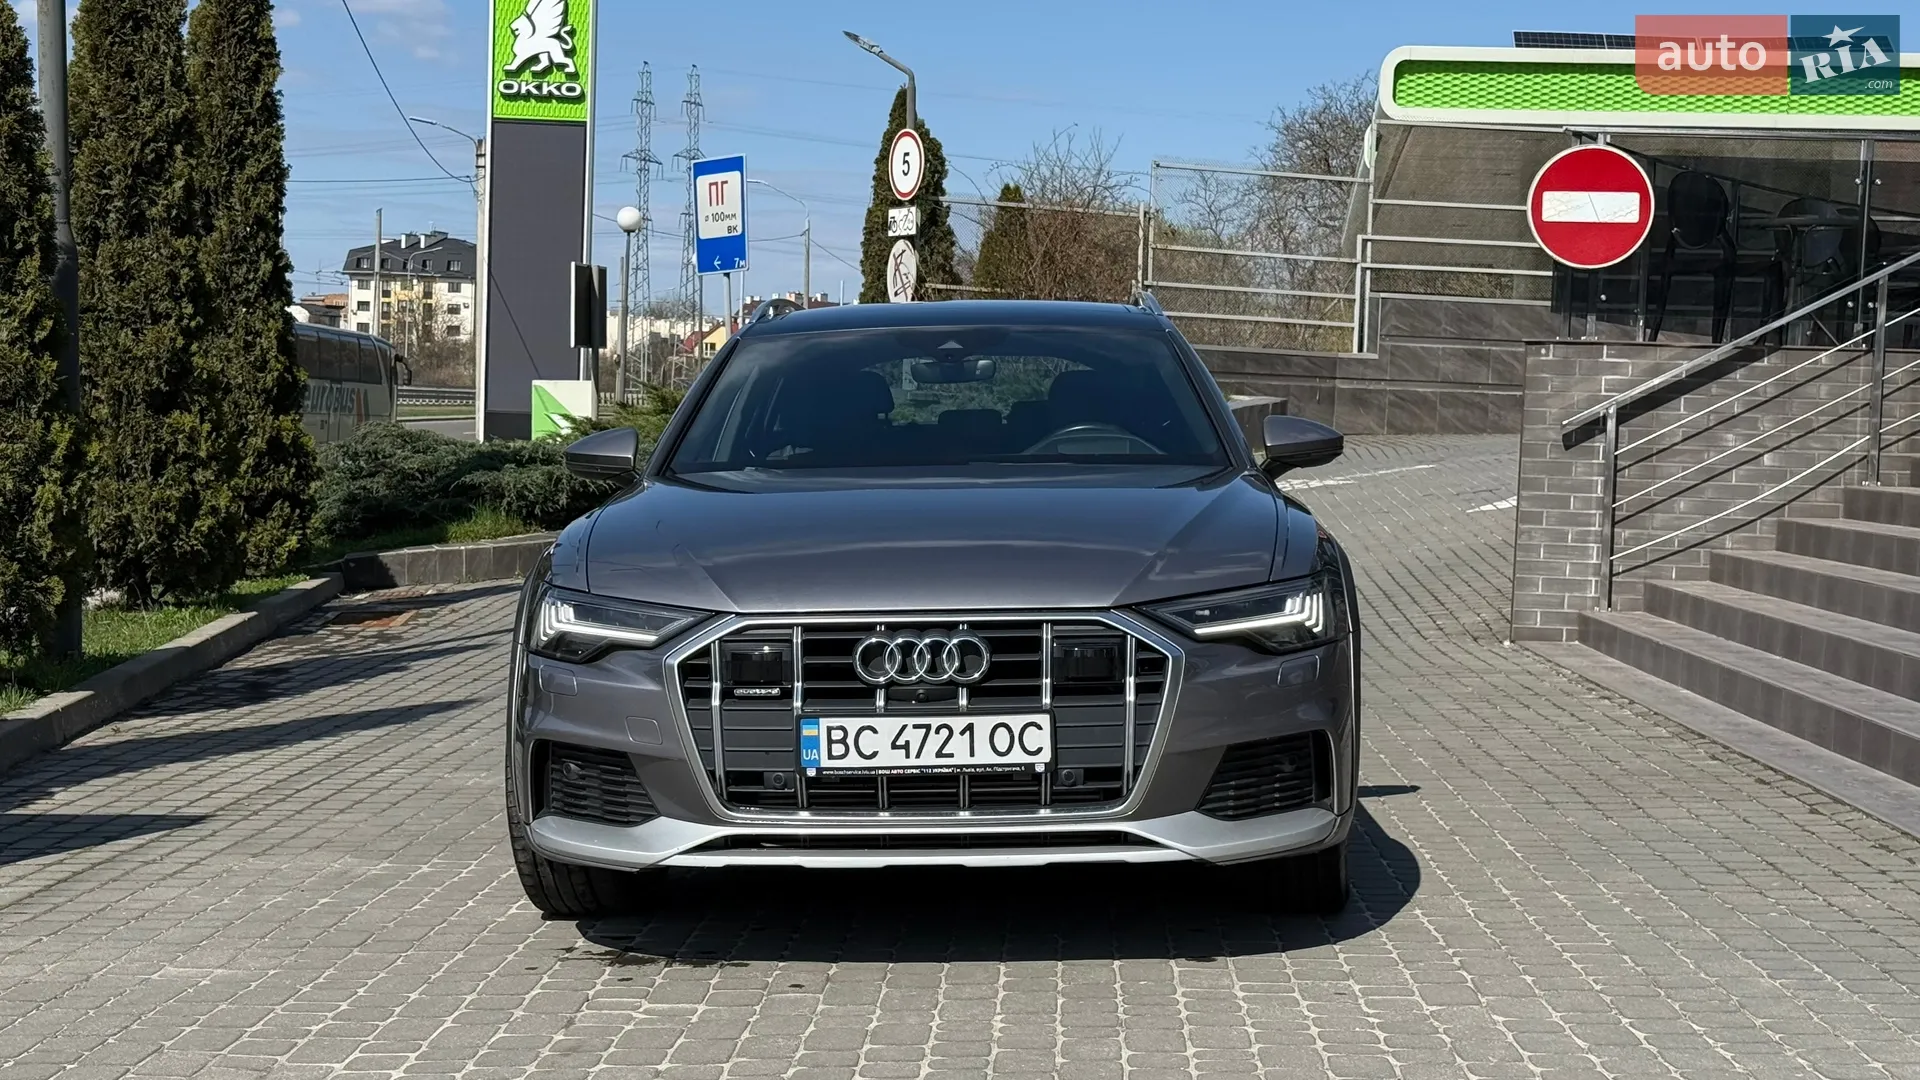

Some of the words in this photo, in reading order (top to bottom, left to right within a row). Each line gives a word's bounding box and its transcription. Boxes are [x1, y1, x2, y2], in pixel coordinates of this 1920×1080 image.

[498, 80, 582, 97] OKKO
[902, 152, 910, 177] 5
[709, 180, 728, 207] ПГ
[826, 724, 879, 761] BC
[890, 722, 975, 760] 4721
[988, 721, 1044, 757] OC
[803, 750, 819, 760] UA
